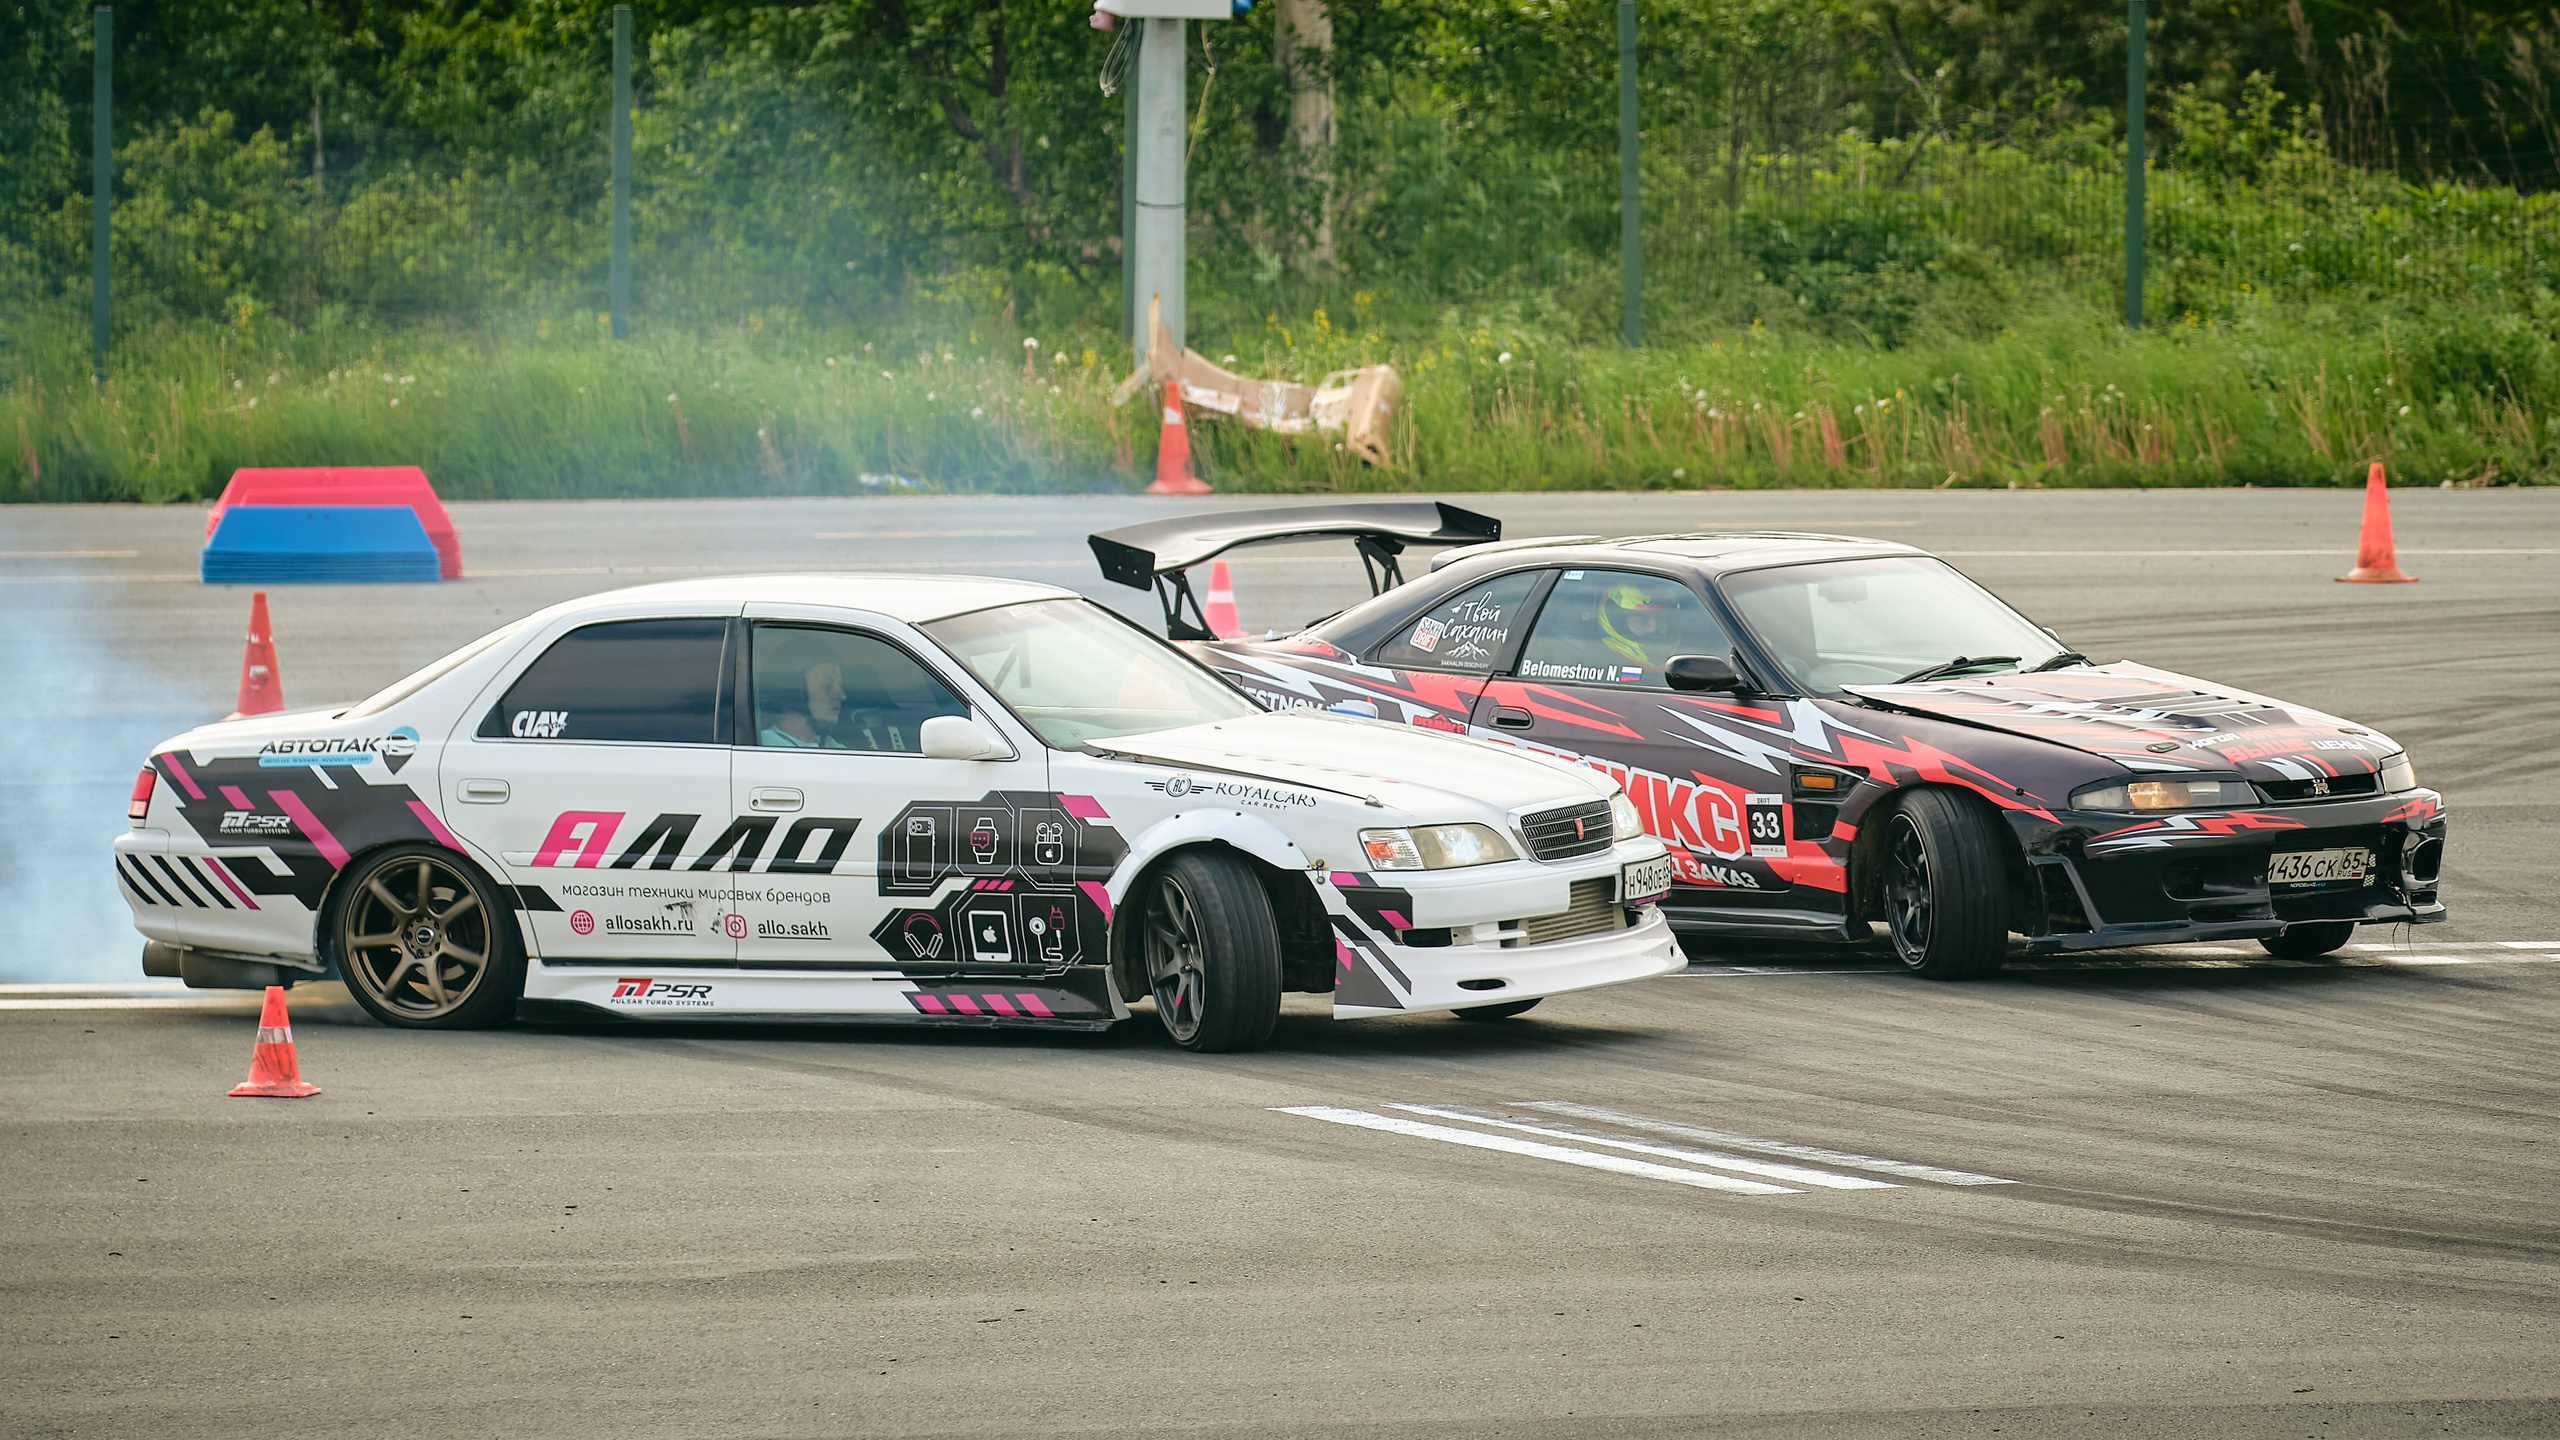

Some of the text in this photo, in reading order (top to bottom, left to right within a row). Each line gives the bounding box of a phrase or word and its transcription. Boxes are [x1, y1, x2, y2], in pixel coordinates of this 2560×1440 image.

[1464, 591, 1501, 622] Твой
[1420, 618, 1444, 636] SAKH
[1442, 618, 1508, 644] Сахалин
[1412, 630, 1438, 650] DRIFT
[1521, 660, 1604, 681] Belomestnov
[259, 736, 383, 755] АВТОПАК
[2186, 732, 2242, 750] КОГДА
[2219, 738, 2369, 764] ВЫШЕ ЦЕНЫ
[1215, 782, 1319, 808] ROYALCARS
[1240, 799, 1288, 811] CAR RENT
[1752, 811, 1780, 839] 33
[2342, 851, 2363, 870] 65
[1685, 859, 1761, 889] ЗАКАЗ
[2337, 870, 2352, 878] RUS
[562, 884, 831, 906] магазин техники мировых брендов
[605, 915, 693, 931] allosakh.ru
[758, 920, 829, 936] allo.sakh
[647, 983, 713, 998] PSR
